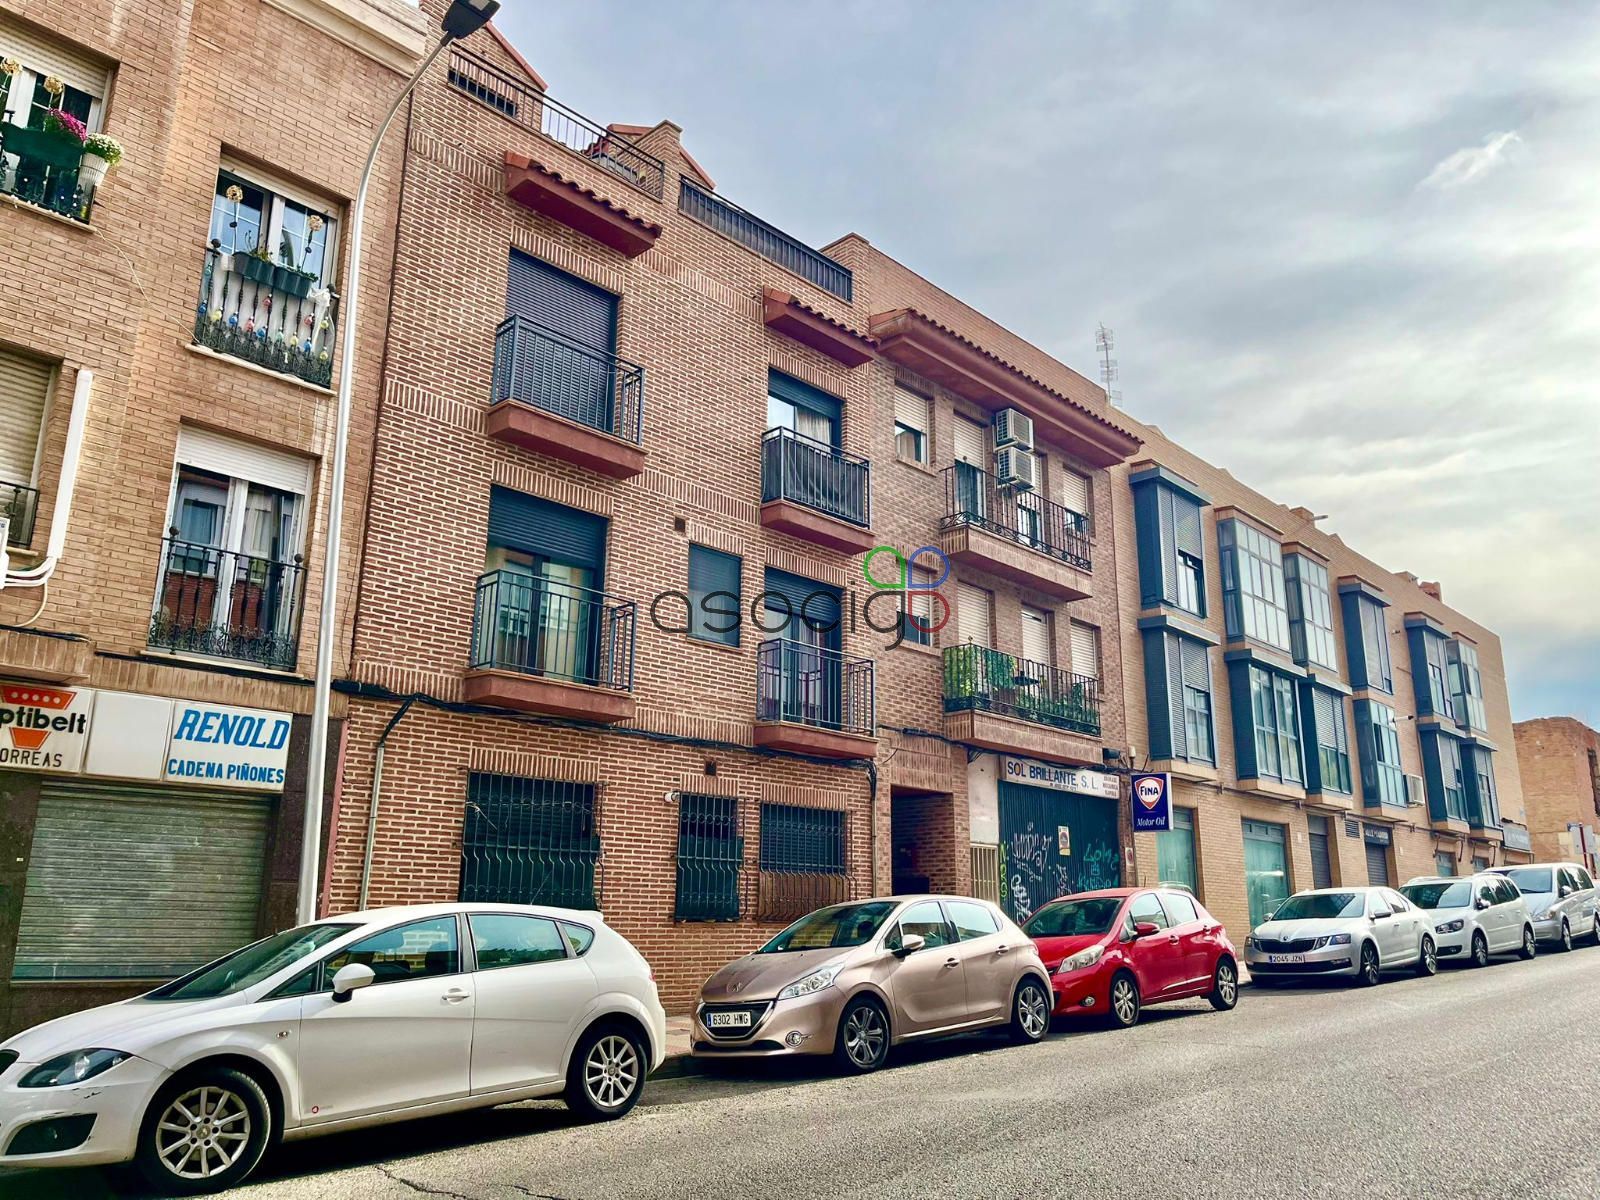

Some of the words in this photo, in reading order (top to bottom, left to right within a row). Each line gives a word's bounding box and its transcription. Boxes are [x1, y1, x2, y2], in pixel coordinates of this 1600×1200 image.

[174, 708, 290, 750] RENOLD
[0, 748, 63, 767] ORREAS
[168, 758, 223, 779] CADENA
[227, 762, 284, 784] PIÑONES
[1007, 761, 1027, 778] SOL
[1140, 786, 1159, 796] FINA
[1137, 818, 1155, 827] Motor
[1155, 816, 1166, 826] Oil
[712, 1014, 731, 1025] 6302
